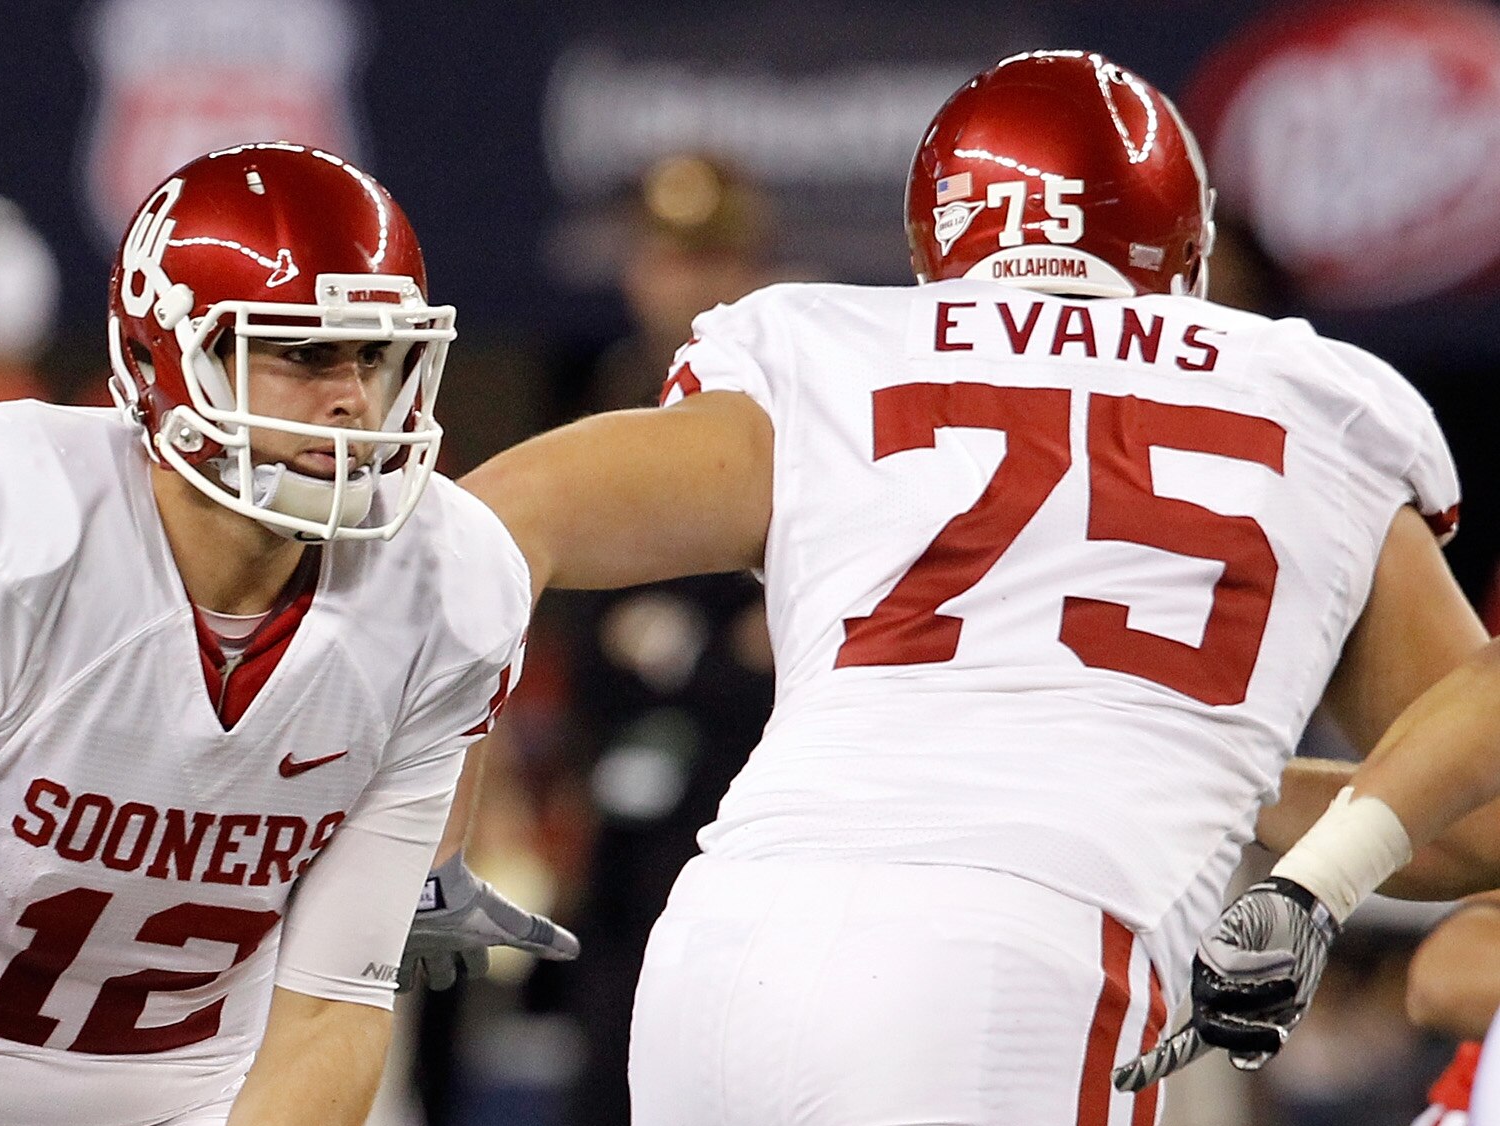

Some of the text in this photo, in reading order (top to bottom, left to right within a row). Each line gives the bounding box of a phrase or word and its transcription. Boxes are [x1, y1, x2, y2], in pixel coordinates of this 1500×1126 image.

[986, 178, 1085, 247] 75
[992, 258, 1088, 278] OKLAHOMA
[934, 301, 1227, 372] EVANS
[833, 381, 1287, 706] 75
[11, 777, 348, 888] SOONERS
